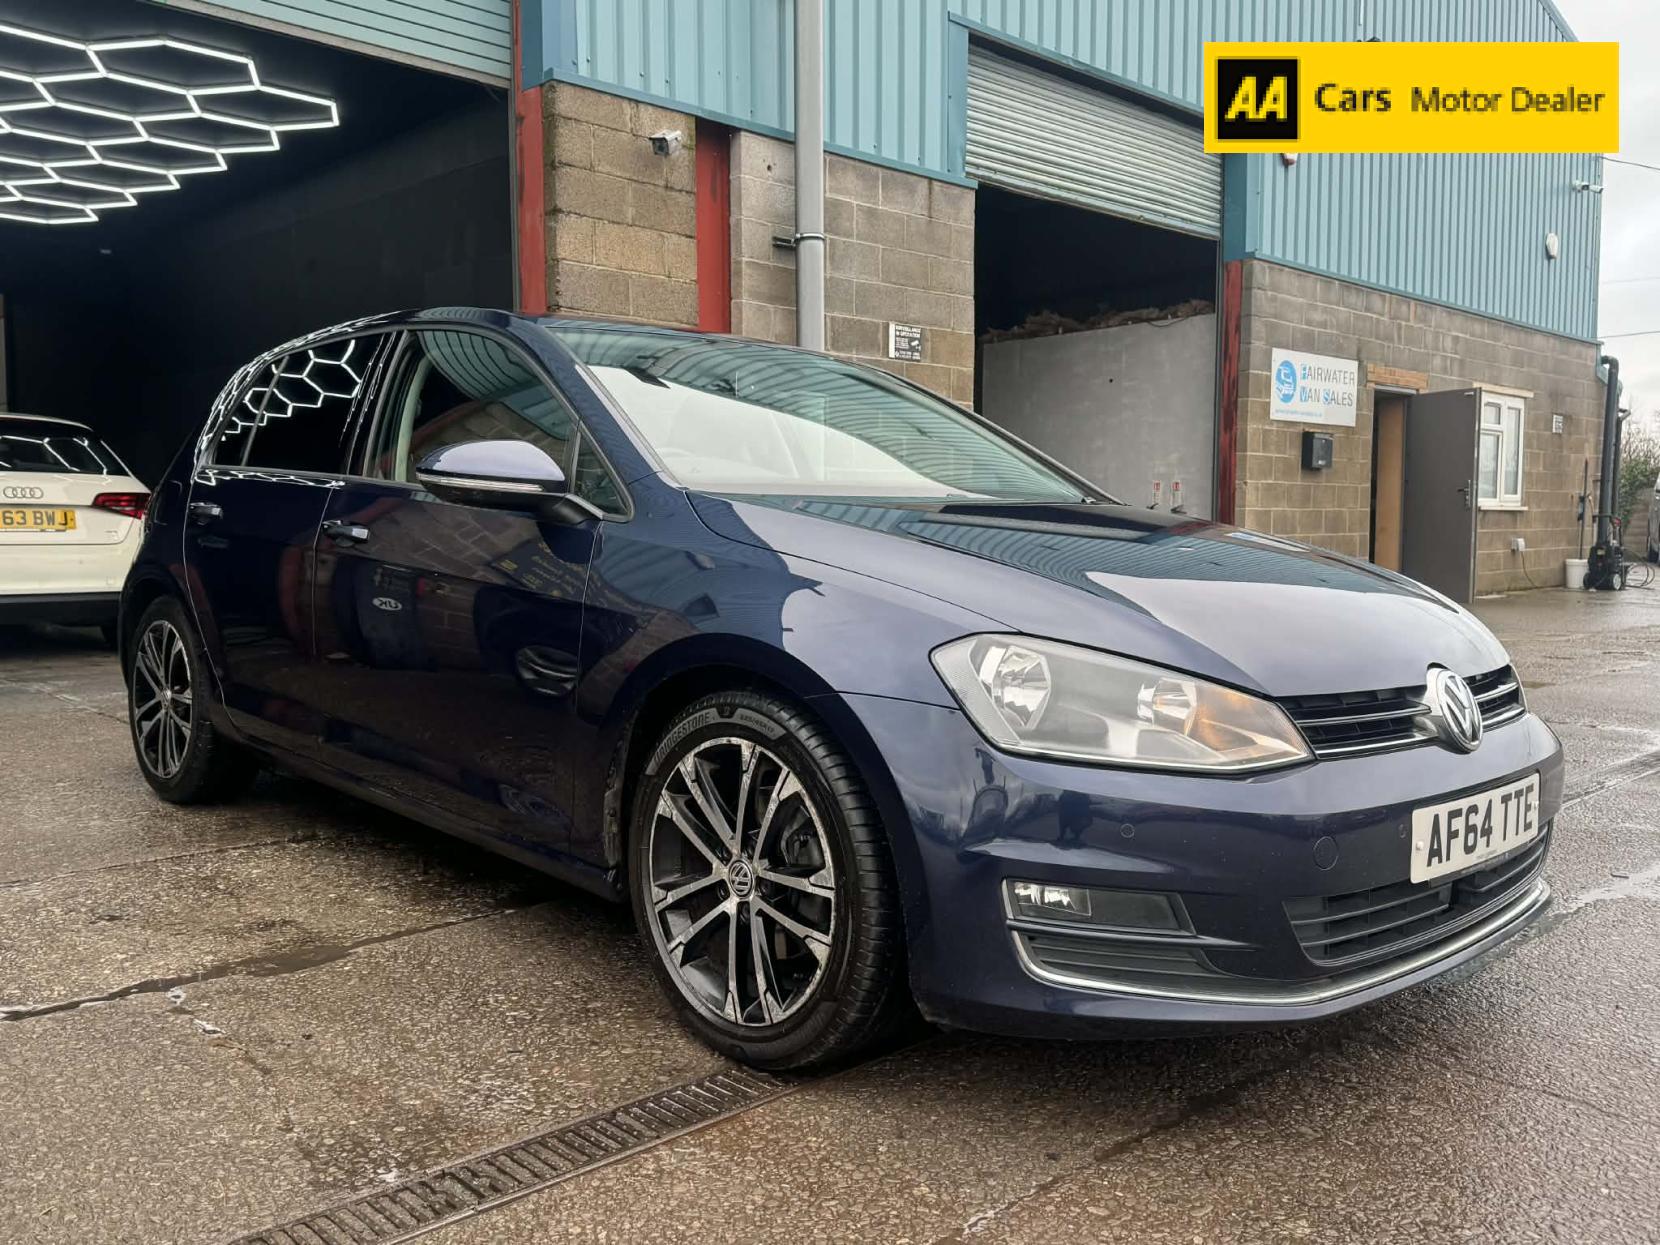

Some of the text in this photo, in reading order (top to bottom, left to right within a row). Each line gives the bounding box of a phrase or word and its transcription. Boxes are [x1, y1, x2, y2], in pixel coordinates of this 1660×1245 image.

[1300, 363, 1355, 385] FAIRWATER
[1299, 386, 1353, 407] VAN SALES
[2, 510, 68, 526] 63 BWJ
[1426, 783, 1535, 867] AF64 TTE
